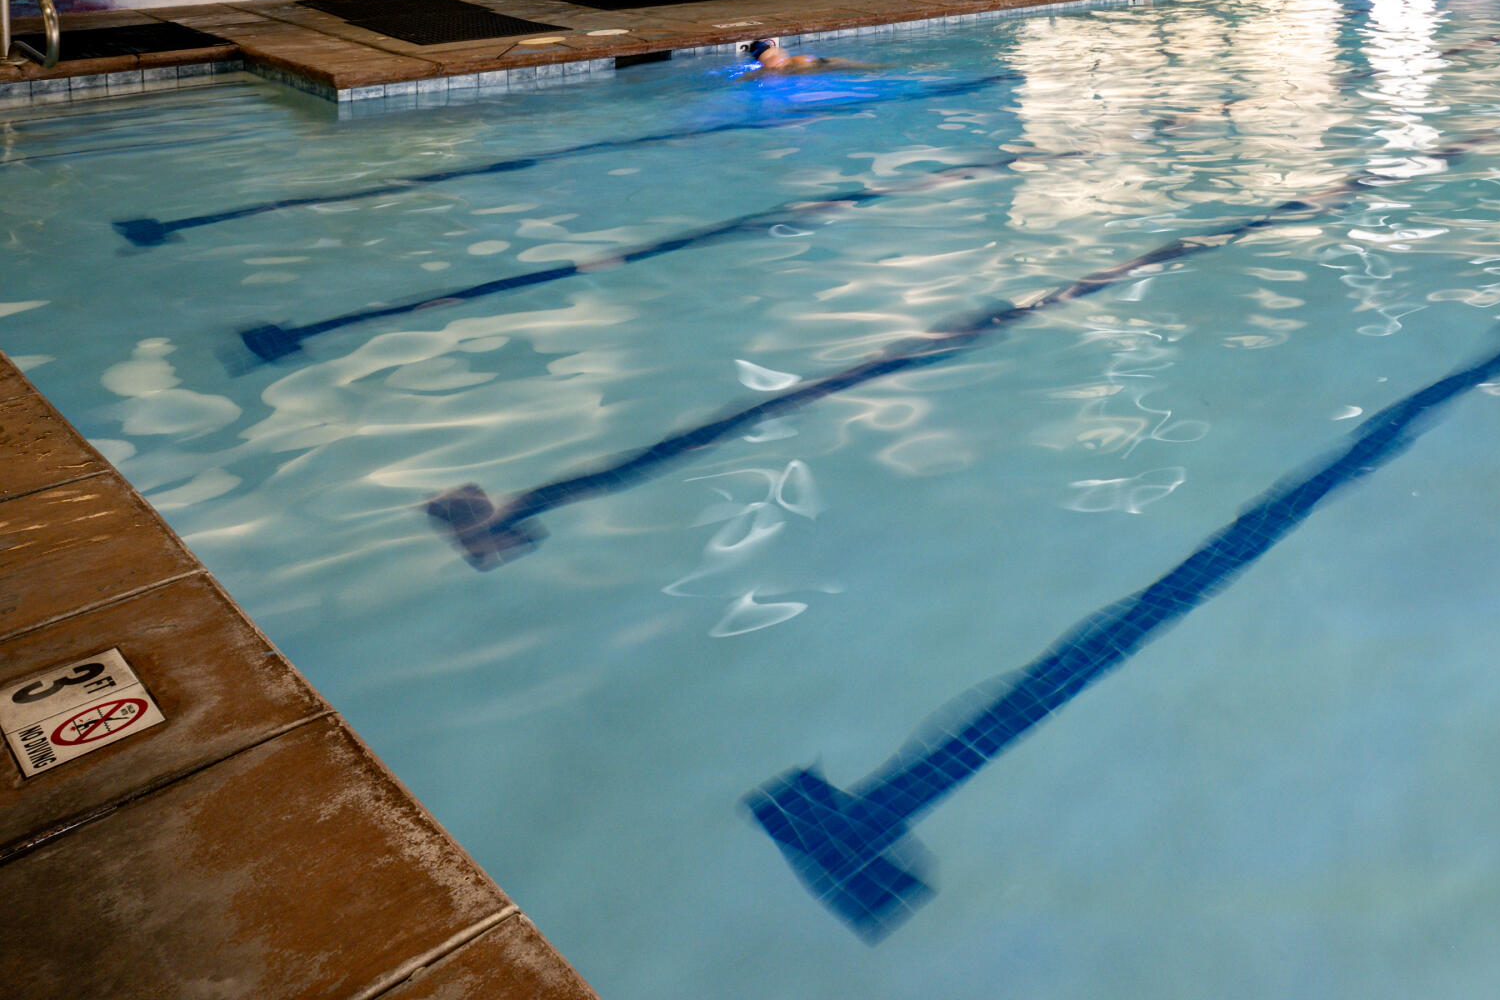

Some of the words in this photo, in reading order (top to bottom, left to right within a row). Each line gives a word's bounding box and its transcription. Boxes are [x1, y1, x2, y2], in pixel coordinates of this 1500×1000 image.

[12, 663, 105, 704] 3
[83, 675, 117, 694] FT
[18, 725, 44, 742] NO
[24, 739, 57, 769] DIVING
